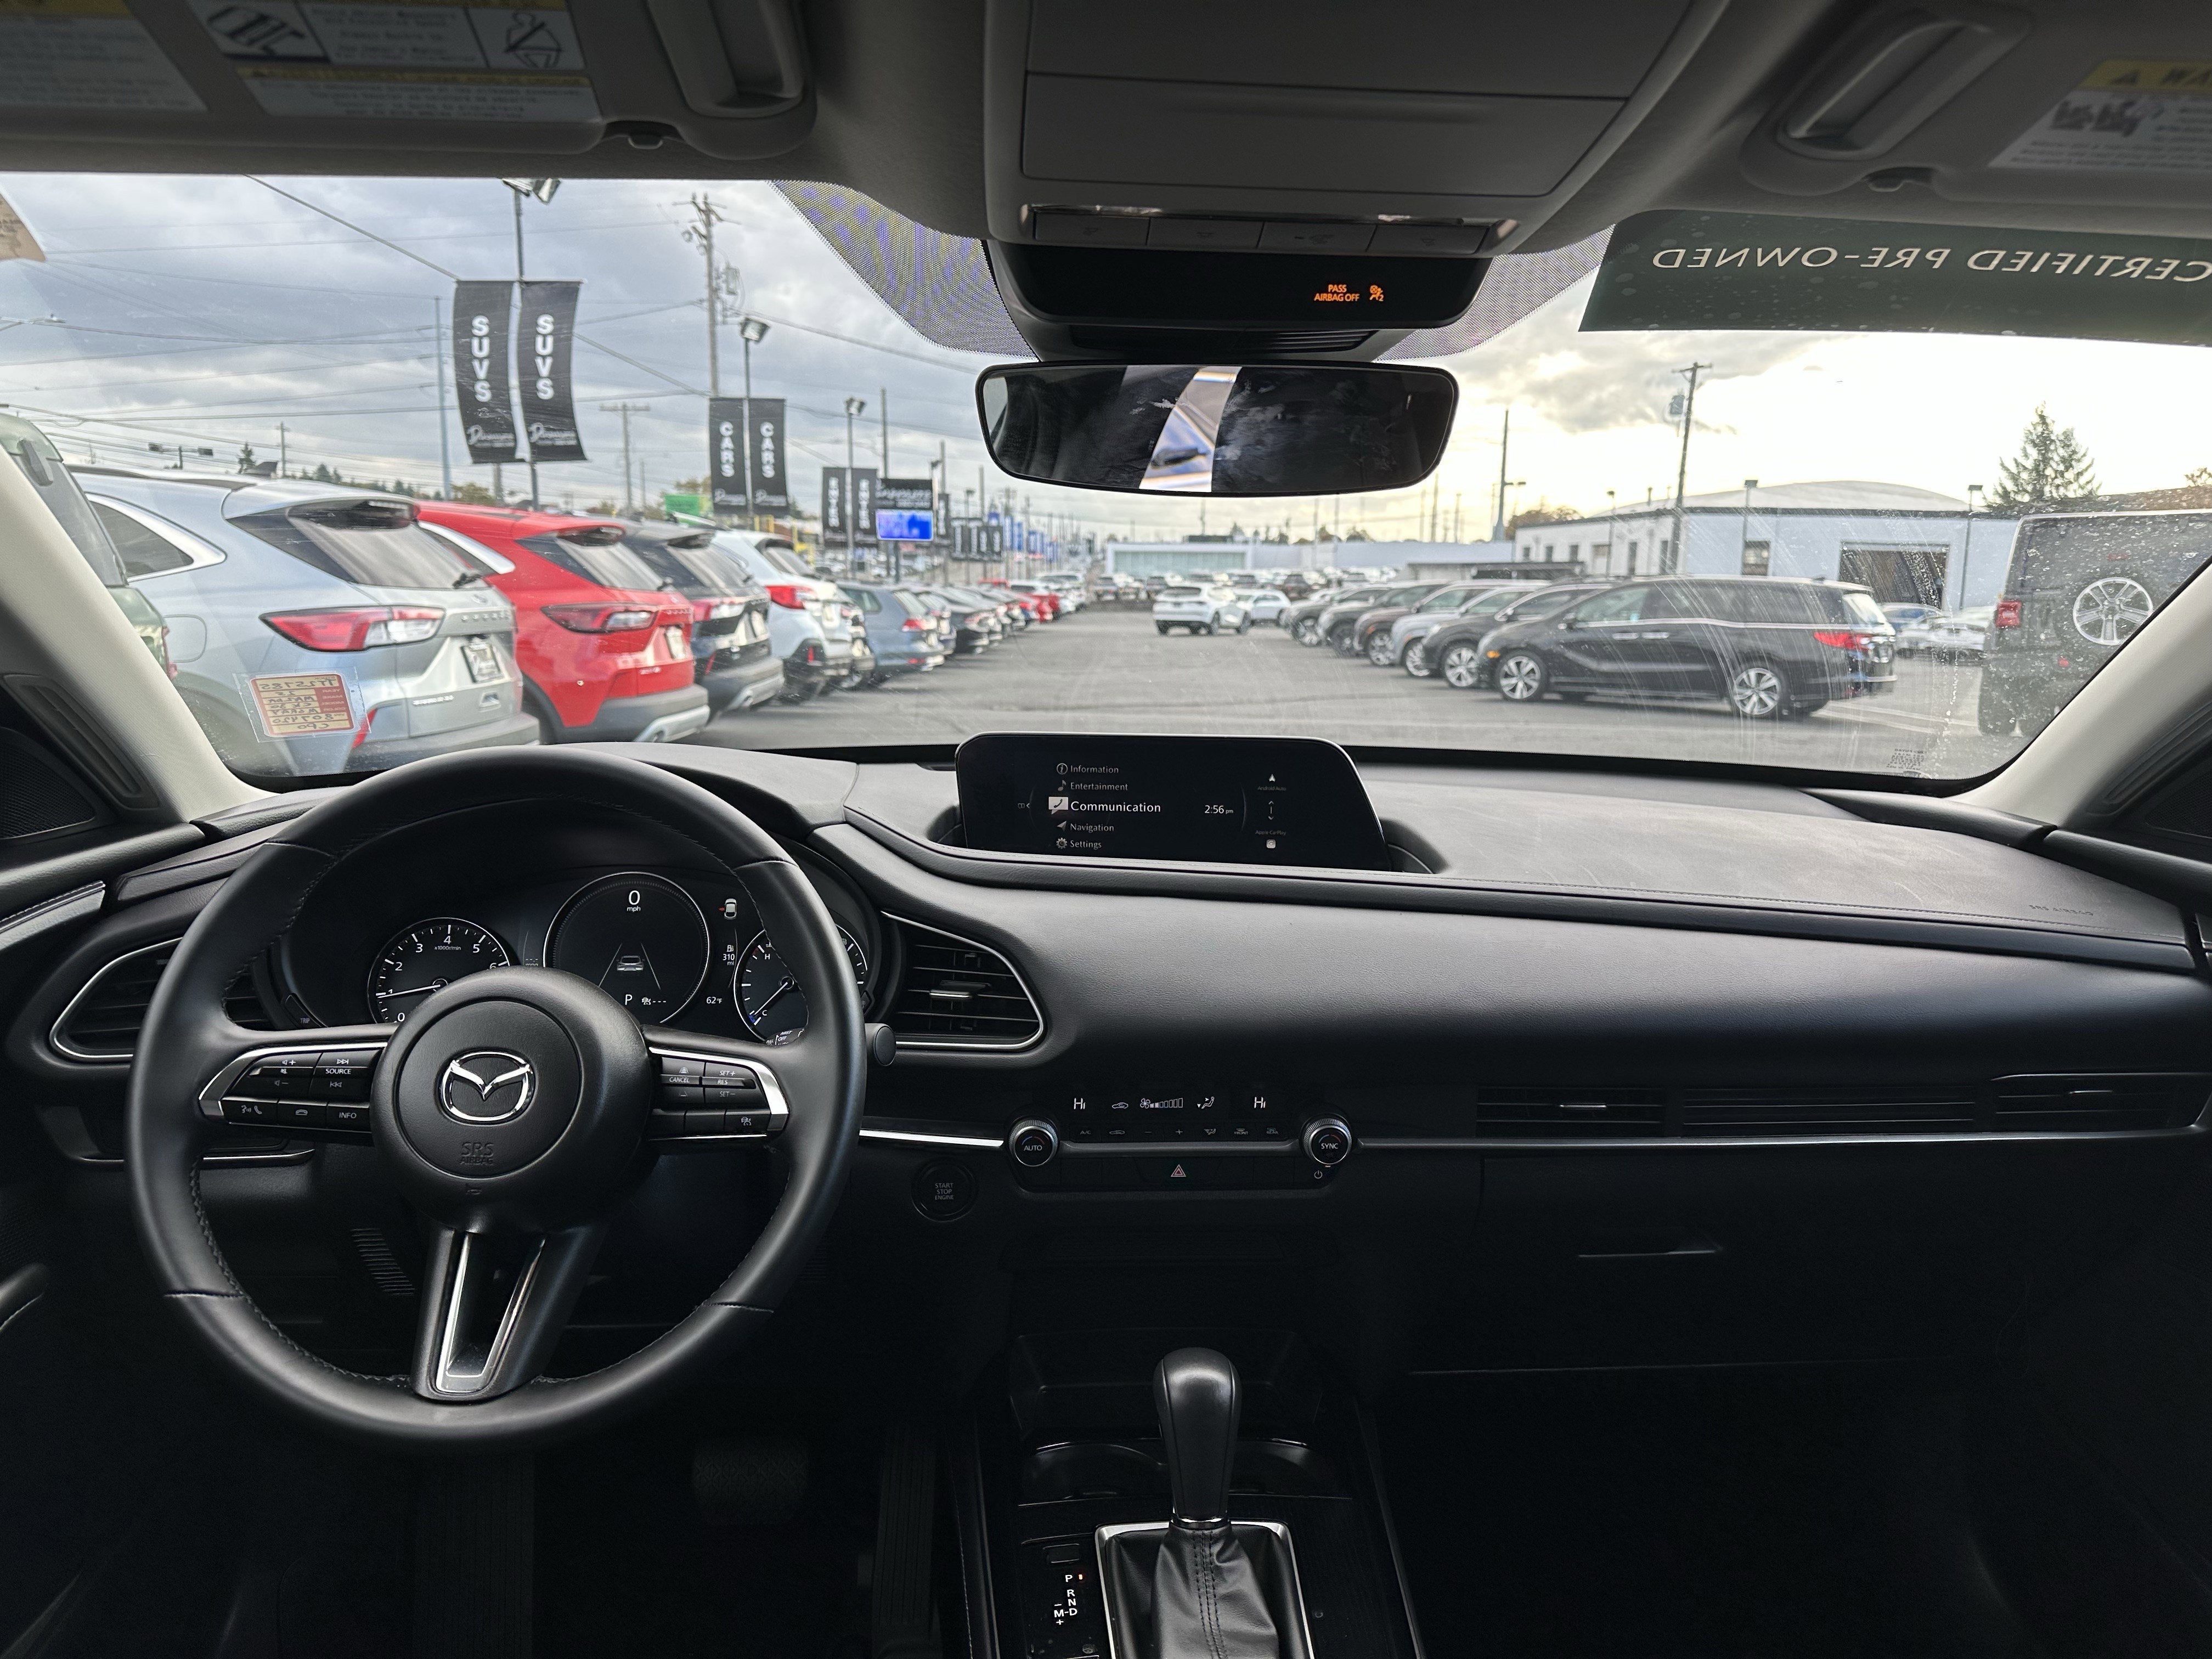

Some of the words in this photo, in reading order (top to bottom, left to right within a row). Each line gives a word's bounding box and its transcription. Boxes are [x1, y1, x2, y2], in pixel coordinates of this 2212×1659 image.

[1328, 284, 1347, 292] PASS
[1313, 293, 1344, 302] AIRBAG
[1345, 293, 1360, 302] OFF
[471, 315, 492, 402] SUVS
[534, 314, 555, 400] SUVS
[719, 421, 735, 477] CARS
[760, 421, 775, 478] CARS
[1070, 765, 1119, 774] Information
[1070, 782, 1128, 791] Entertainment
[1070, 801, 1161, 812] Communication
[1204, 805, 1224, 814] 2:56
[1070, 823, 1114, 833] Navigation
[1070, 840, 1102, 850] Settings
[628, 890, 640, 905] 0
[443, 935, 452, 945] 4
[415, 943, 423, 953] 3
[472, 944, 480, 953] 5
[395, 962, 403, 971] 2
[625, 994, 633, 1005] P
[397, 1012, 405, 1022] 0
[461, 1142, 494, 1155] SRS
[459, 1156, 494, 1165] AIRBAG
[1065, 1575, 1073, 1583] P
[1066, 1589, 1075, 1598] R
[1068, 1598, 1076, 1606] N
